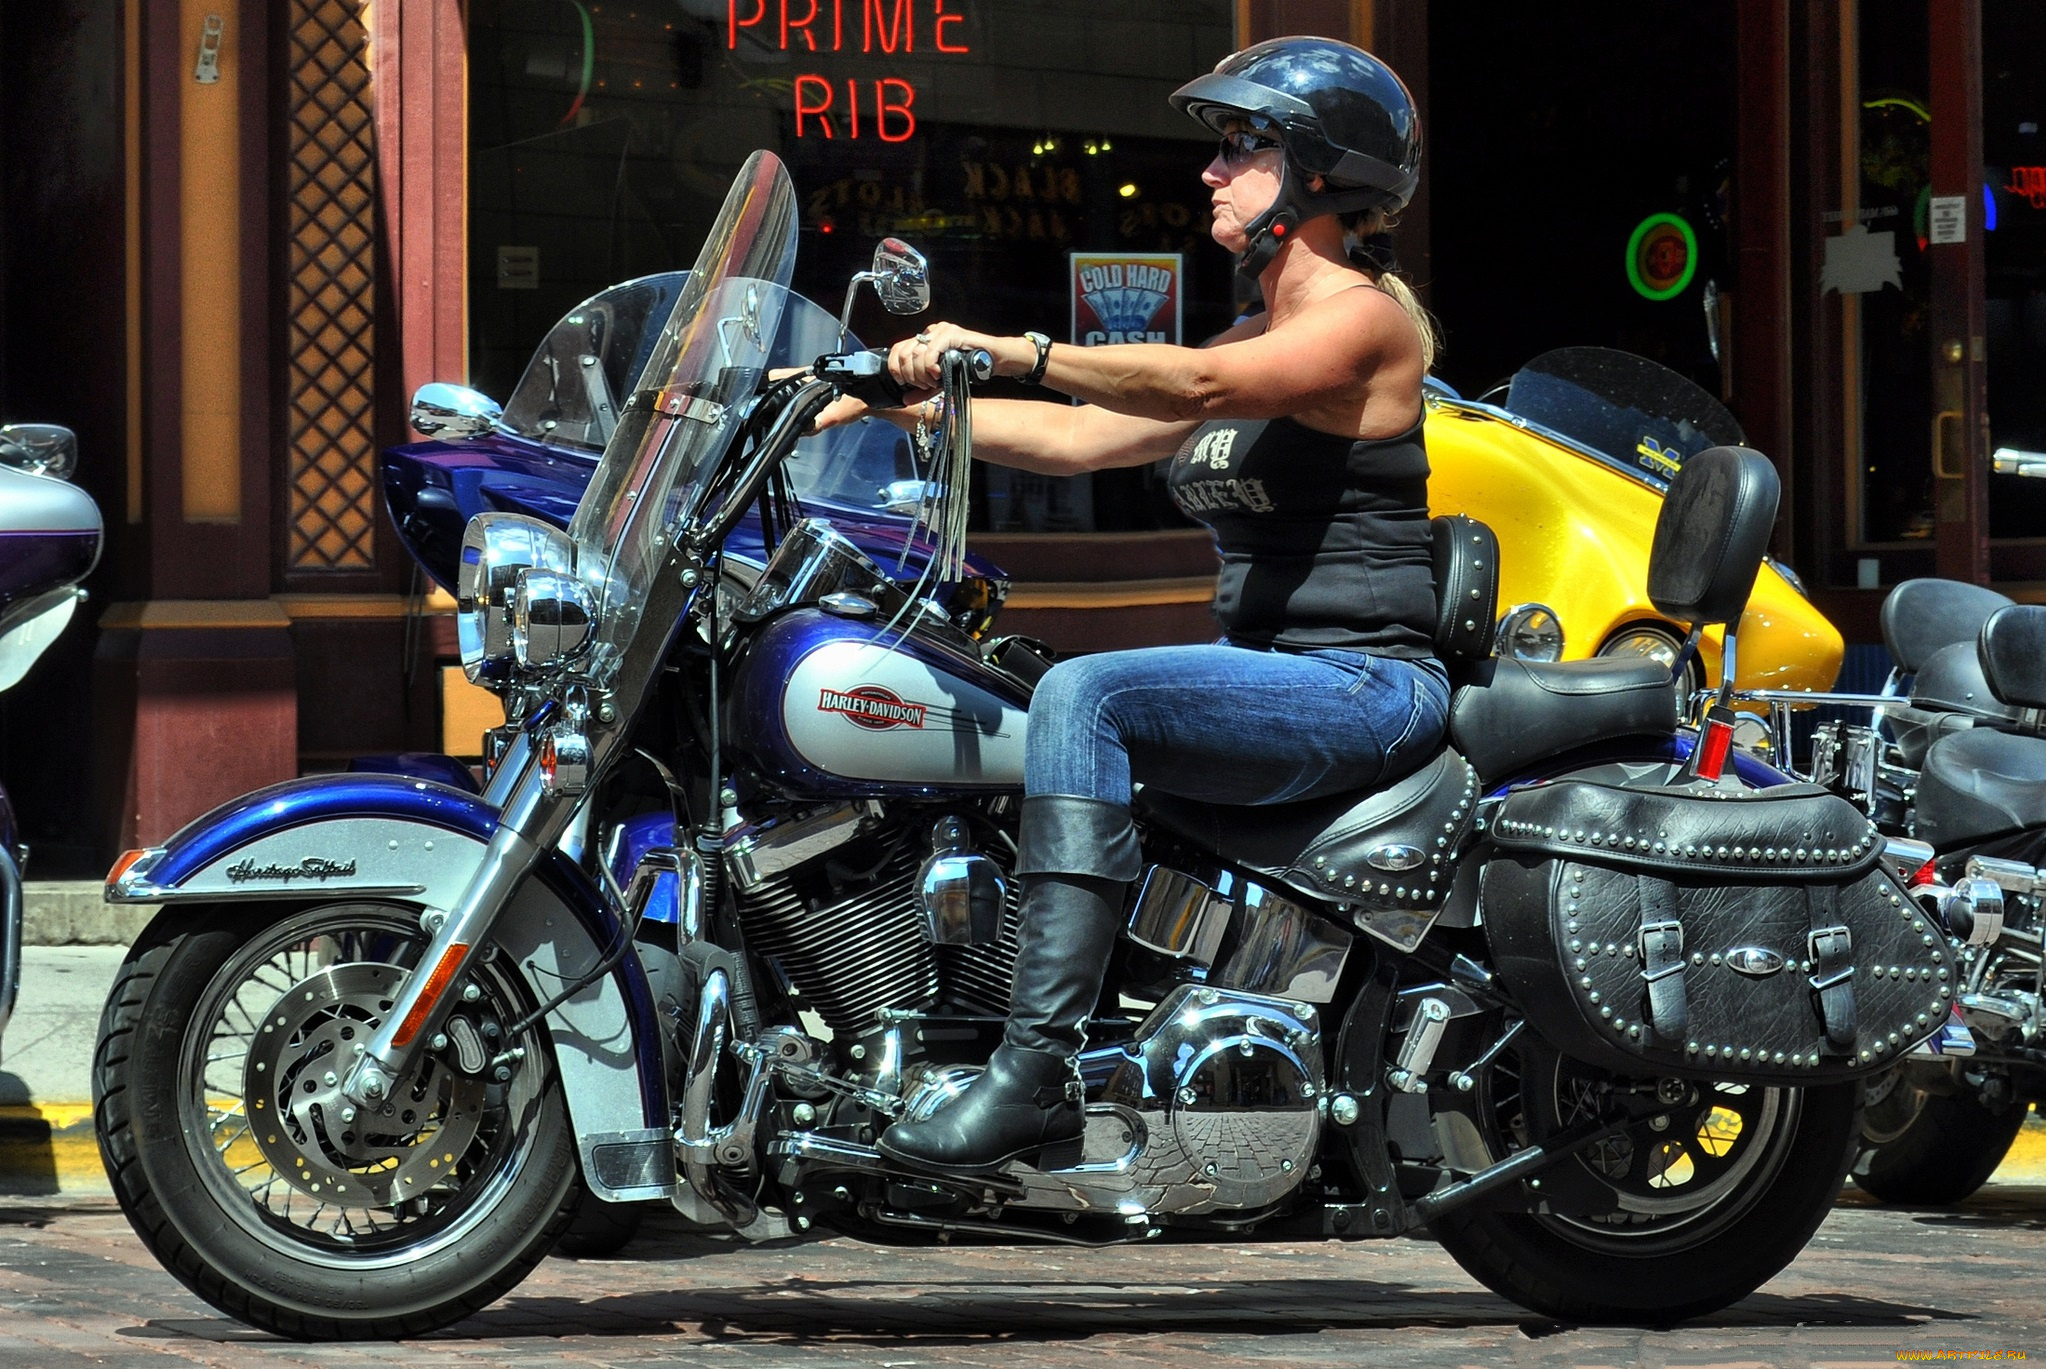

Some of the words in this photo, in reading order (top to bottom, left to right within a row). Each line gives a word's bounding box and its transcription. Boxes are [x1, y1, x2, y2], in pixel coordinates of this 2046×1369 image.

[728, 0, 970, 53] PRIME
[794, 74, 916, 141] RIB
[1081, 264, 1122, 293] COLD
[1126, 264, 1171, 293] HARD
[821, 691, 922, 725] HARLEY-DAVIDSON
